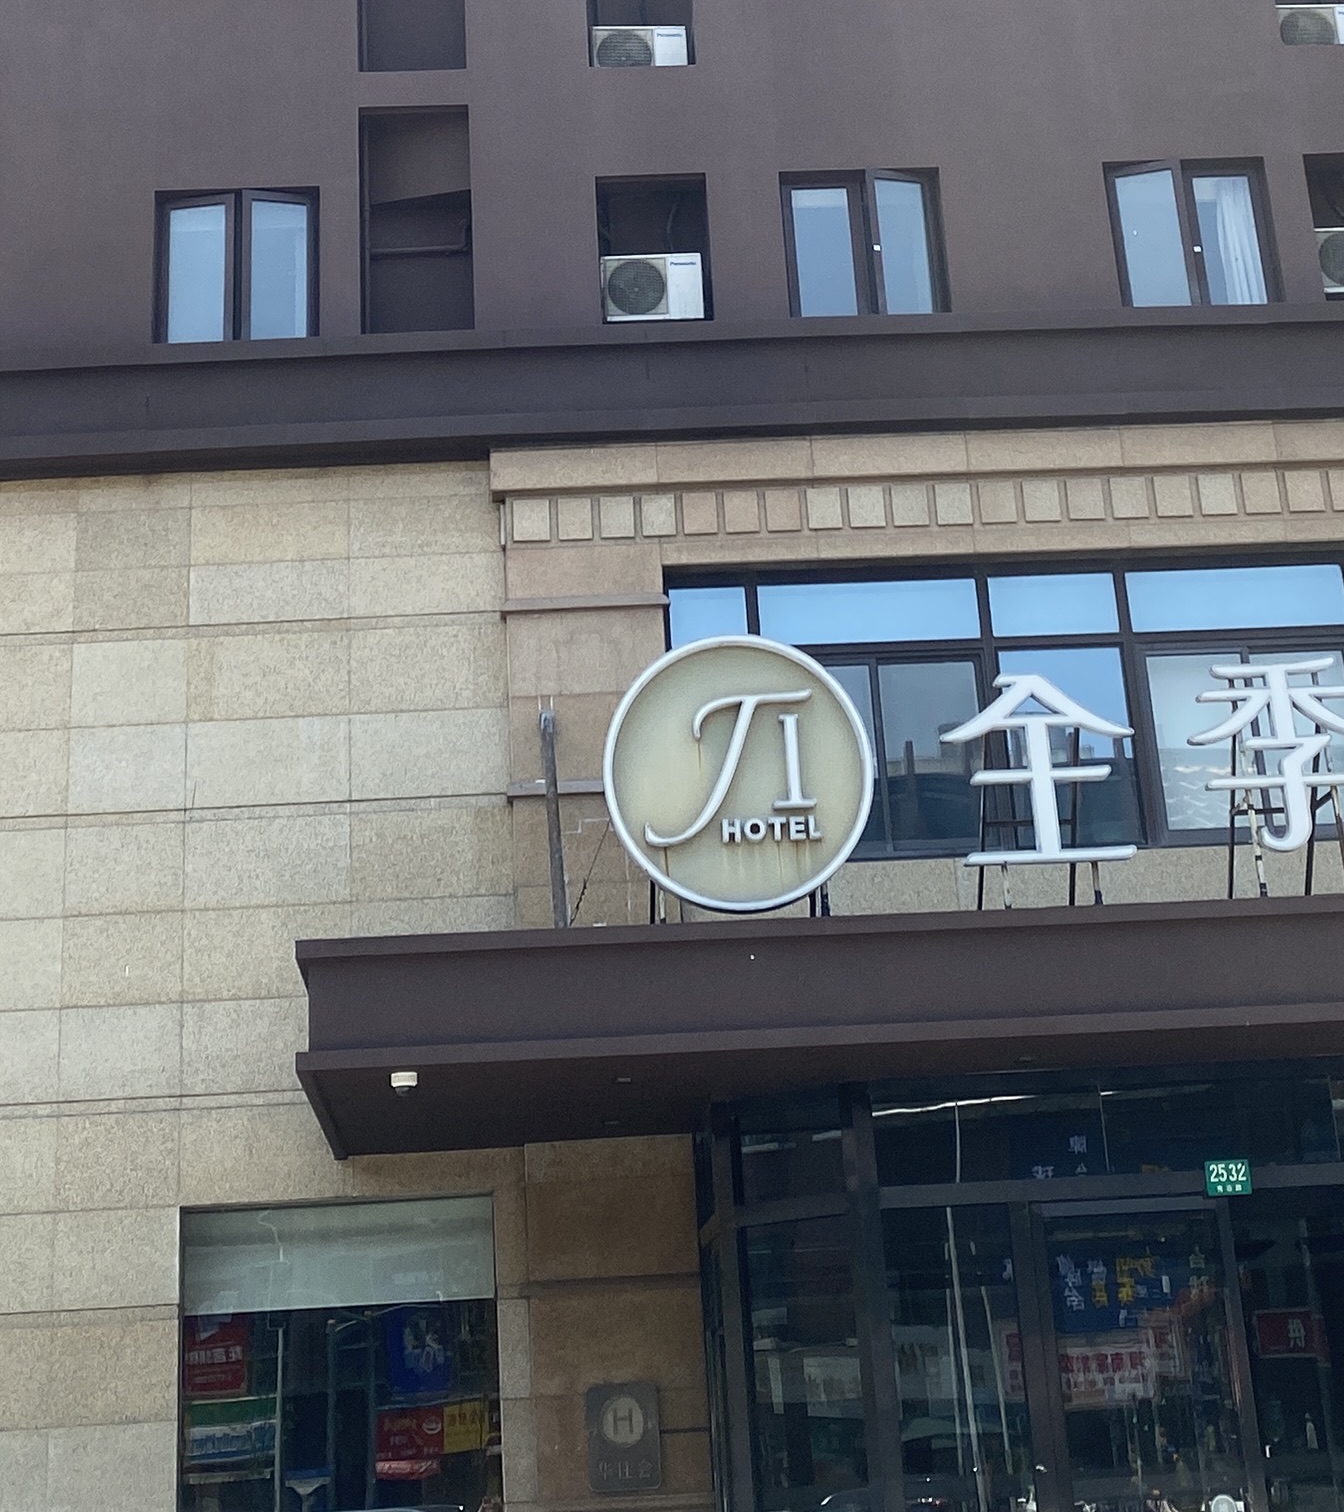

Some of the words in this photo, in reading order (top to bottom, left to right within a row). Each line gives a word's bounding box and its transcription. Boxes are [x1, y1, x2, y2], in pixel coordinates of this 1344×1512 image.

[720, 813, 825, 845] HOTEL
[1209, 1162, 1247, 1183] 2532
[612, 1406, 634, 1435] H
